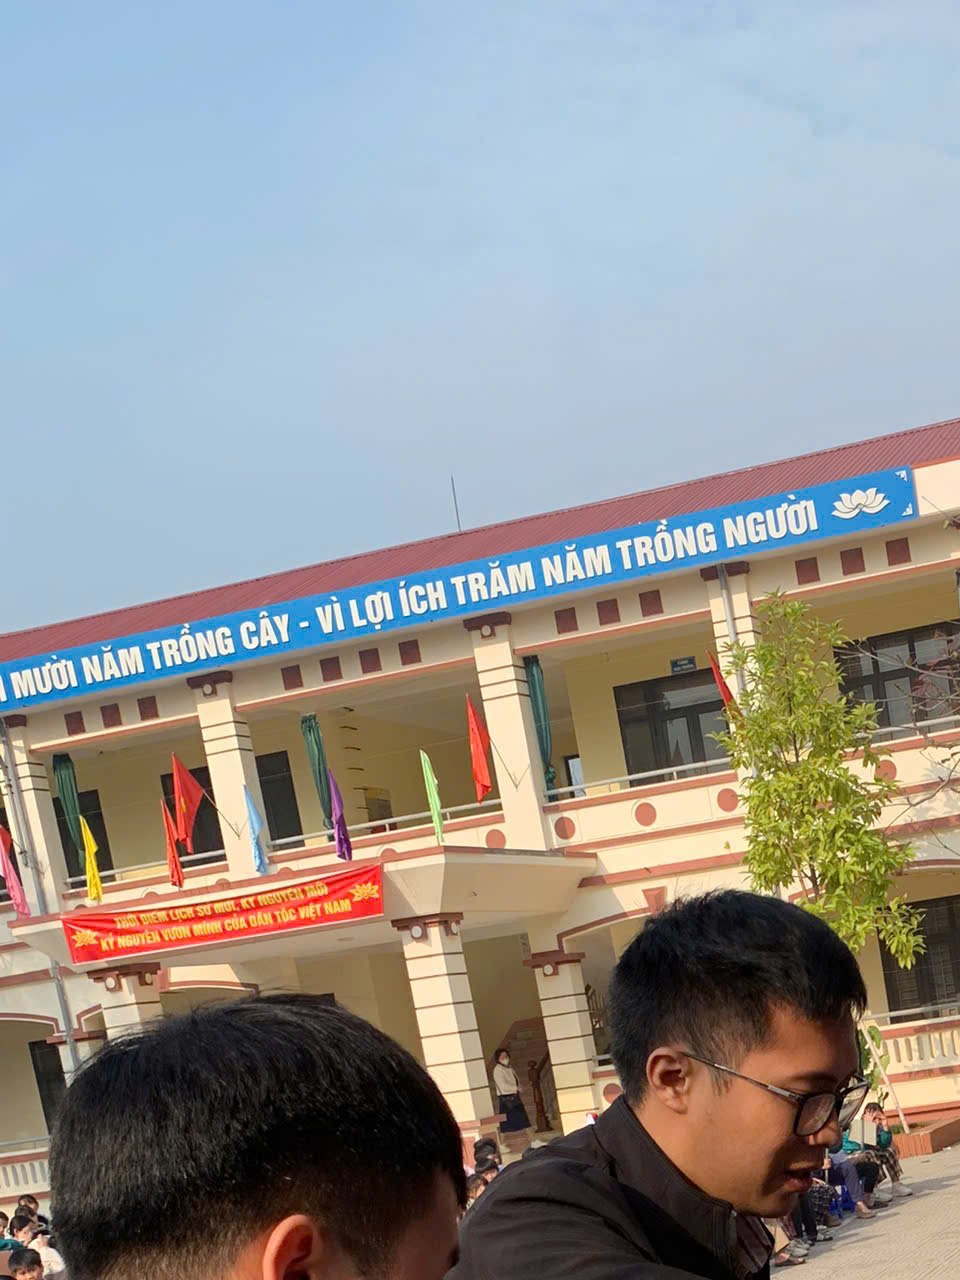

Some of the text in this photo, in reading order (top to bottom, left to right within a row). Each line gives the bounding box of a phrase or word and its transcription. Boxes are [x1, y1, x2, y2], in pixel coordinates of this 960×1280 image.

[10, 655, 78, 699] MƯỜI
[81, 644, 145, 685] NĂM
[146, 623, 236, 670] TRỒNG
[240, 611, 289, 649] CÂY
[315, 596, 345, 634] VÌ
[349, 591, 394, 630] LỢI
[399, 580, 448, 617] ÍCH
[450, 560, 536, 605] TRĂM
[541, 544, 613, 586] NĂM
[616, 518, 717, 570] TRỒNG
[723, 494, 819, 548] NGƯỜI
[298, 903, 321, 921] VIỆT
[324, 899, 352, 915] NAM
